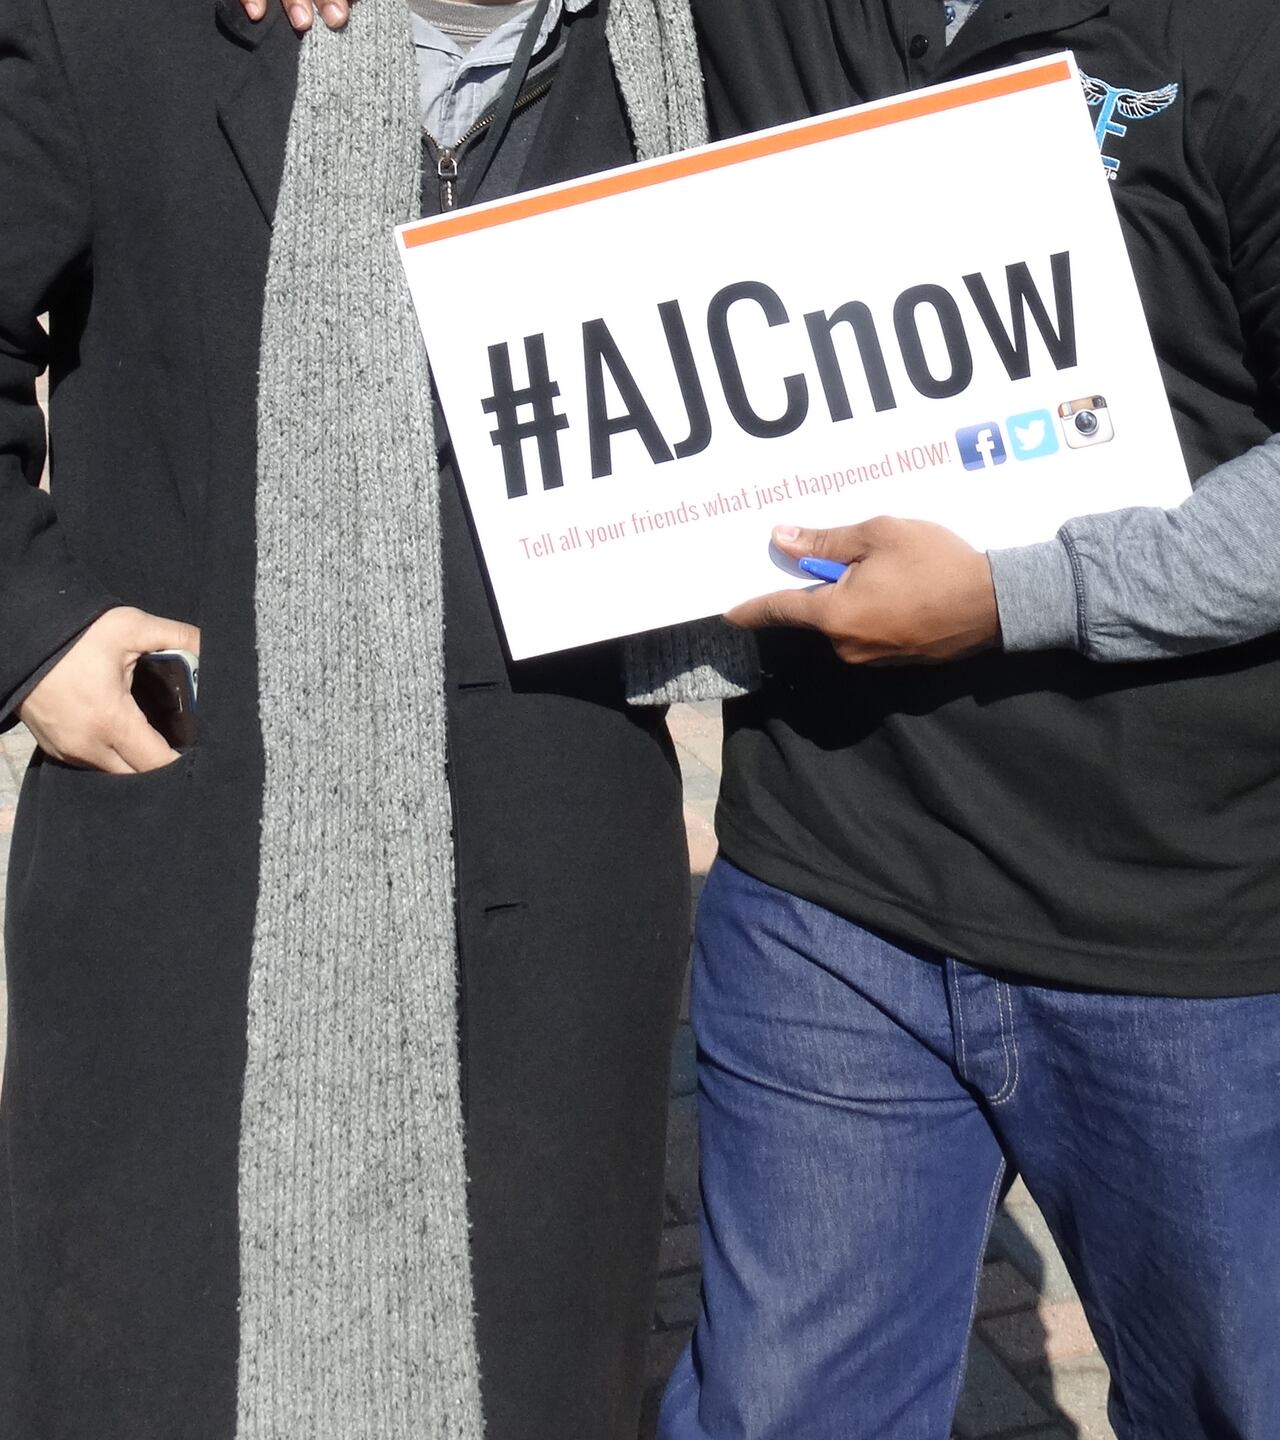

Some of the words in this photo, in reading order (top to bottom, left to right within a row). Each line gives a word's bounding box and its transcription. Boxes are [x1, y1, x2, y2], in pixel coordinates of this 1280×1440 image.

[480, 250, 1078, 500] #AJCnow
[519, 533, 555, 560] Tell
[560, 526, 582, 551] all
[585, 520, 627, 549] your
[631, 501, 700, 534] friends
[702, 488, 751, 517] what
[754, 478, 793, 510] just
[795, 454, 893, 496] happened
[896, 440, 952, 473] NOW!
